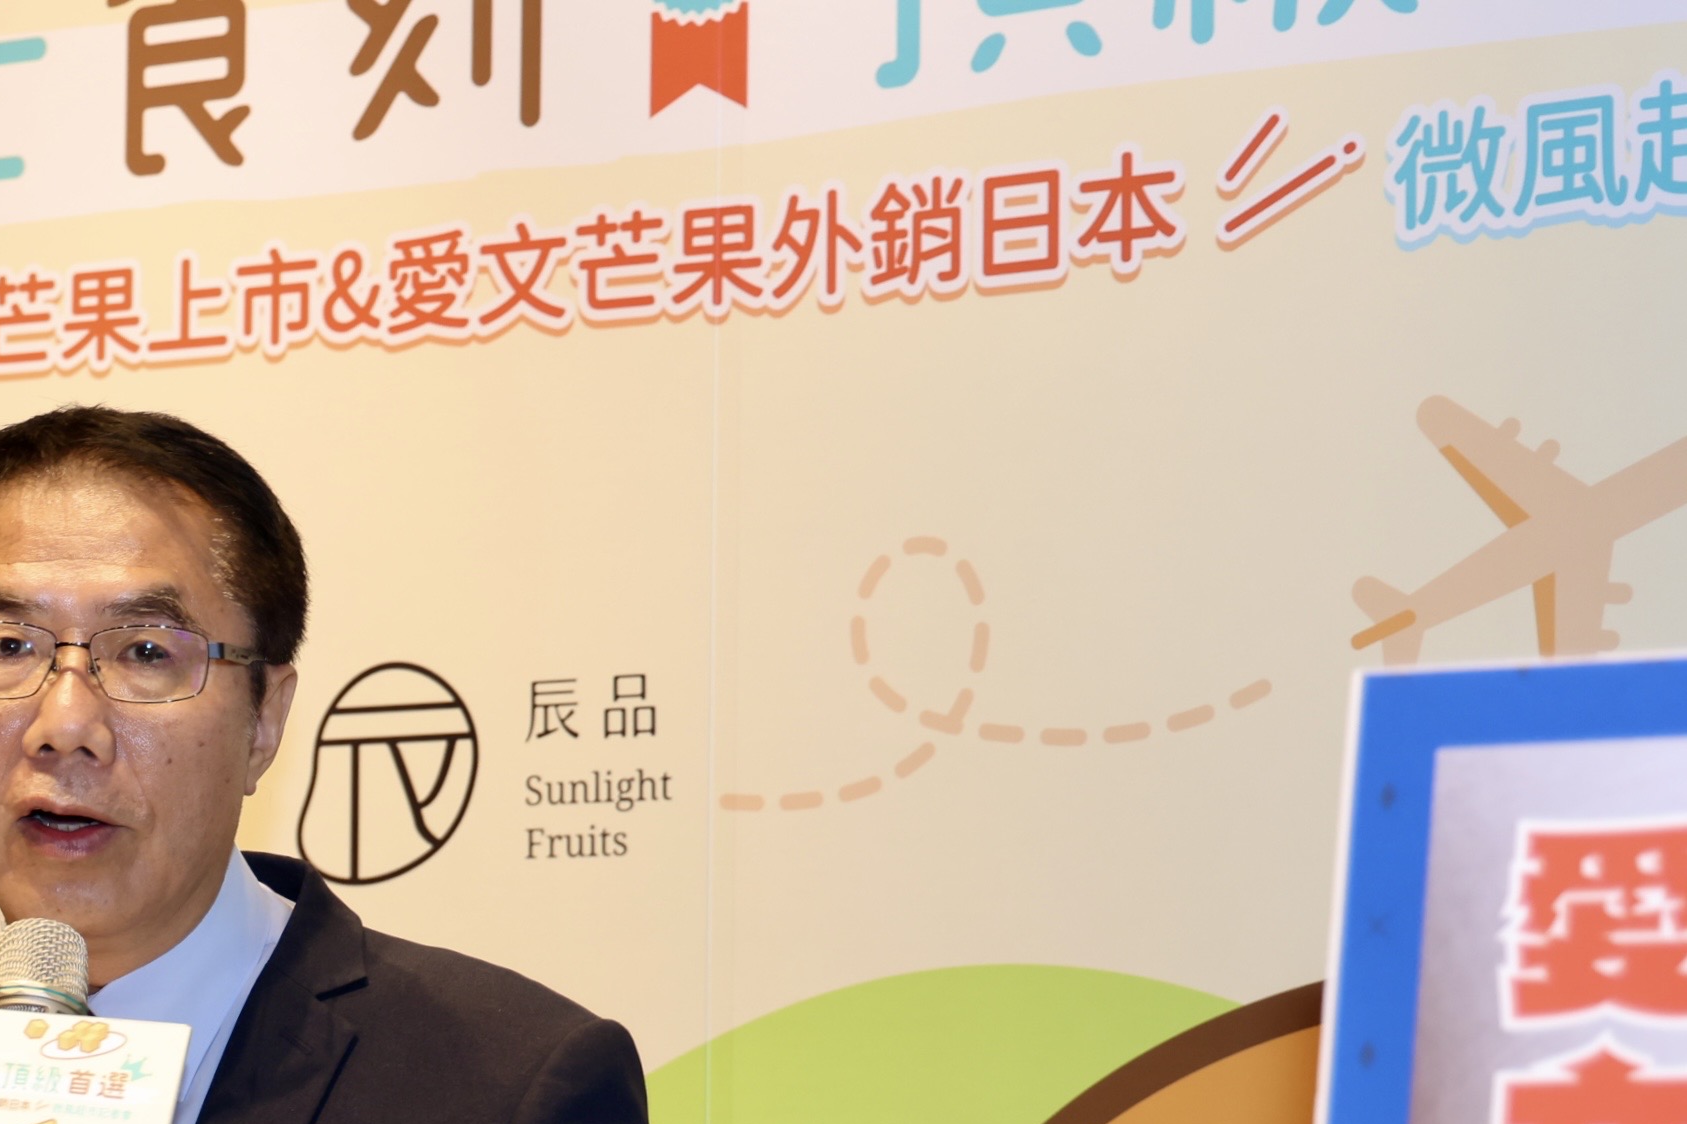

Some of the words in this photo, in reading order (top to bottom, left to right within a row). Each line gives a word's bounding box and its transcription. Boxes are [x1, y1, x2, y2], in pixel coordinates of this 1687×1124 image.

[525, 673, 657, 743] 辰品
[524, 769, 672, 812] Sunlight
[524, 825, 628, 860] Fruits
[1, 1062, 131, 1099] 頂級首選
